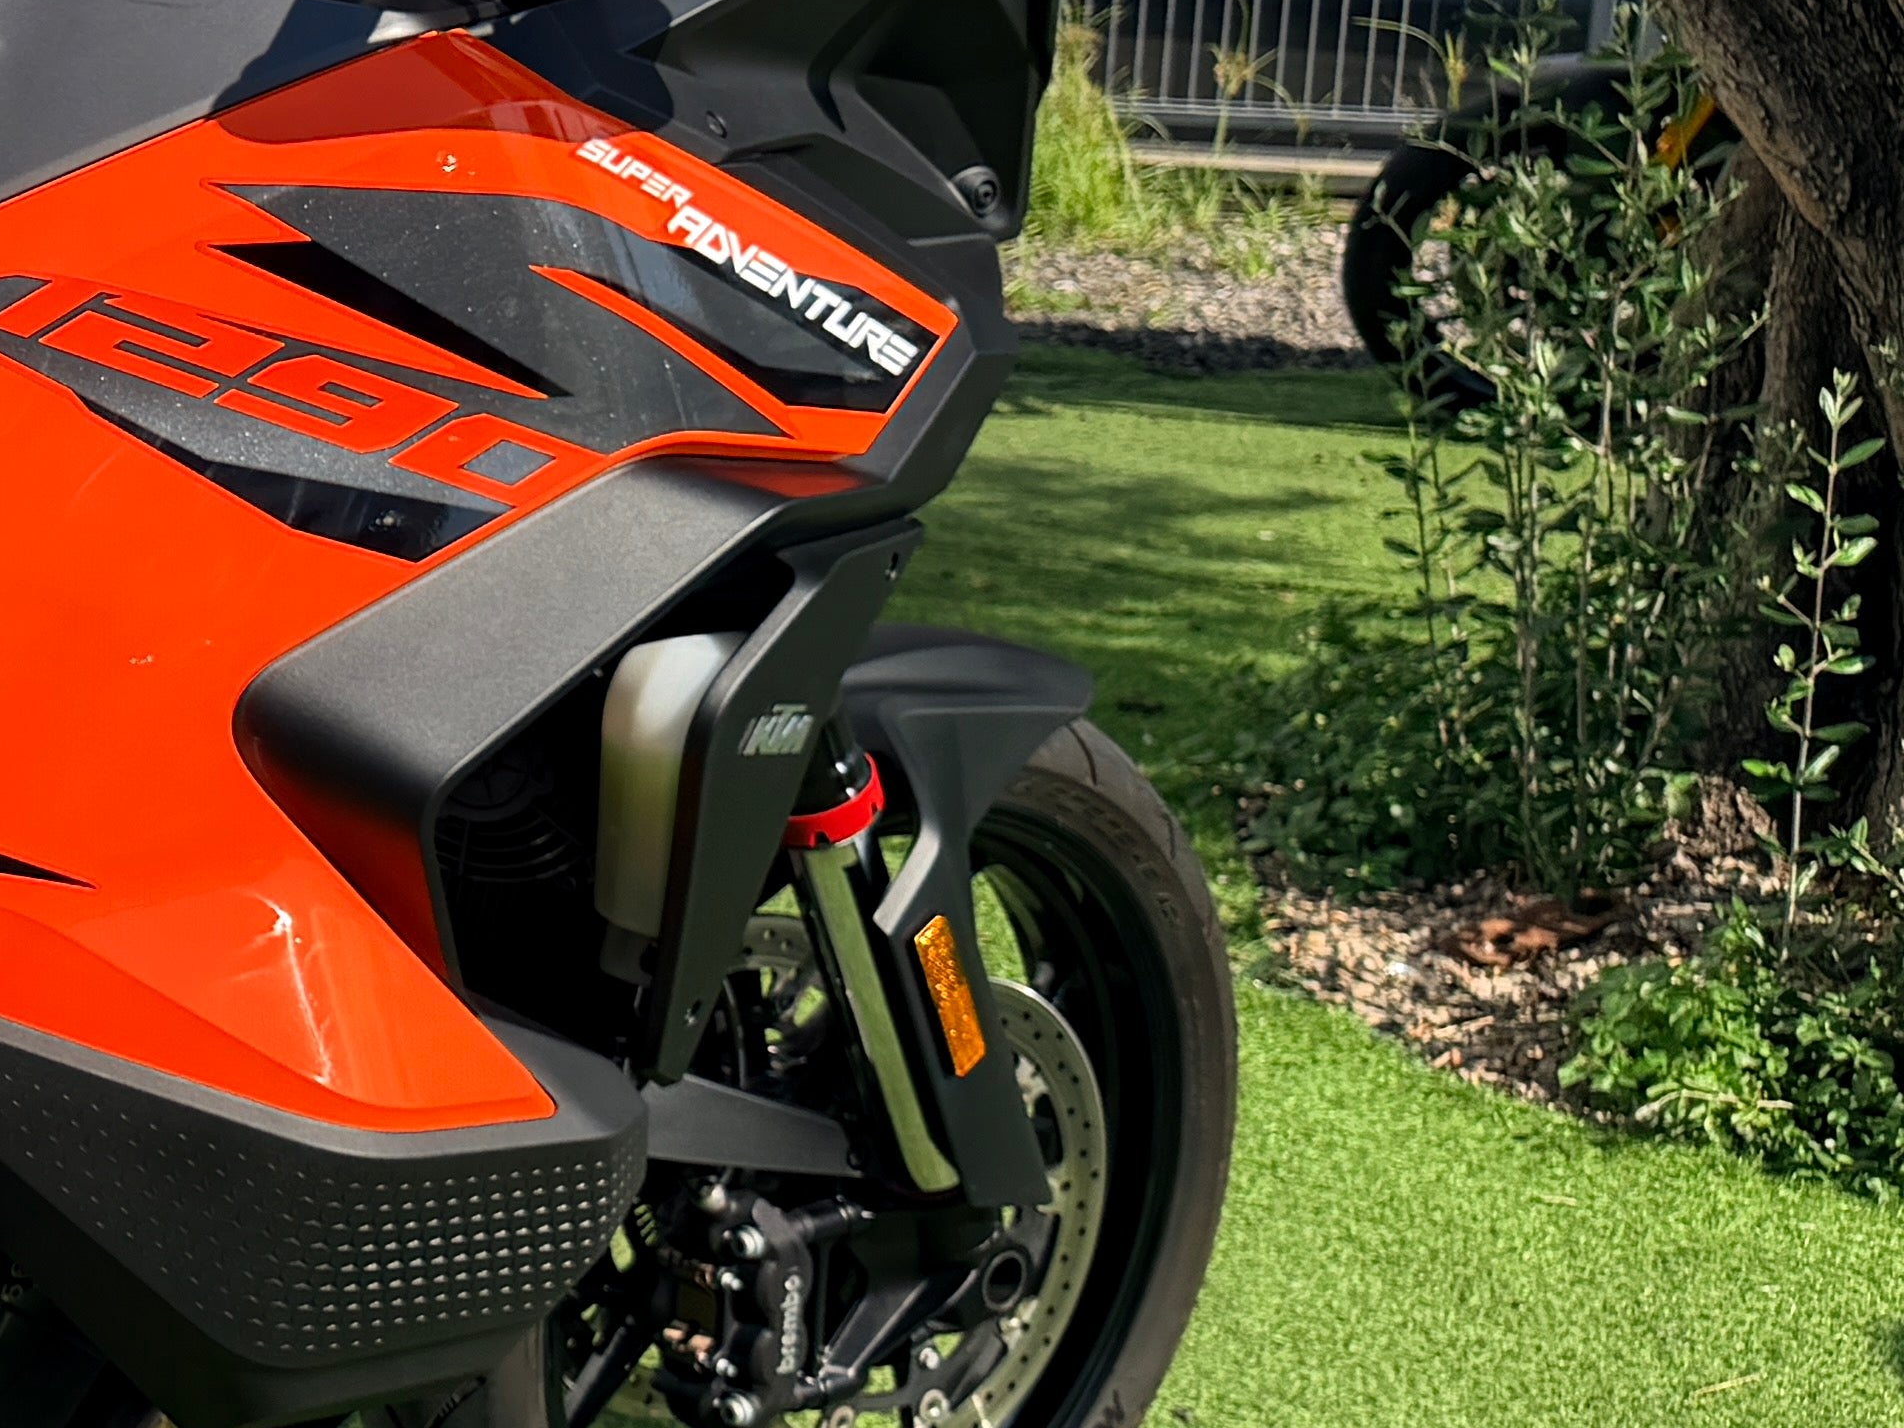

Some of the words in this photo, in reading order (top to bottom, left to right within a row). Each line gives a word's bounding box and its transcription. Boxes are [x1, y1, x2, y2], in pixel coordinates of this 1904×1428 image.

[576, 139, 694, 207] SUPER
[667, 208, 920, 378] ADVENTURE
[777, 1274, 804, 1375] brembo
